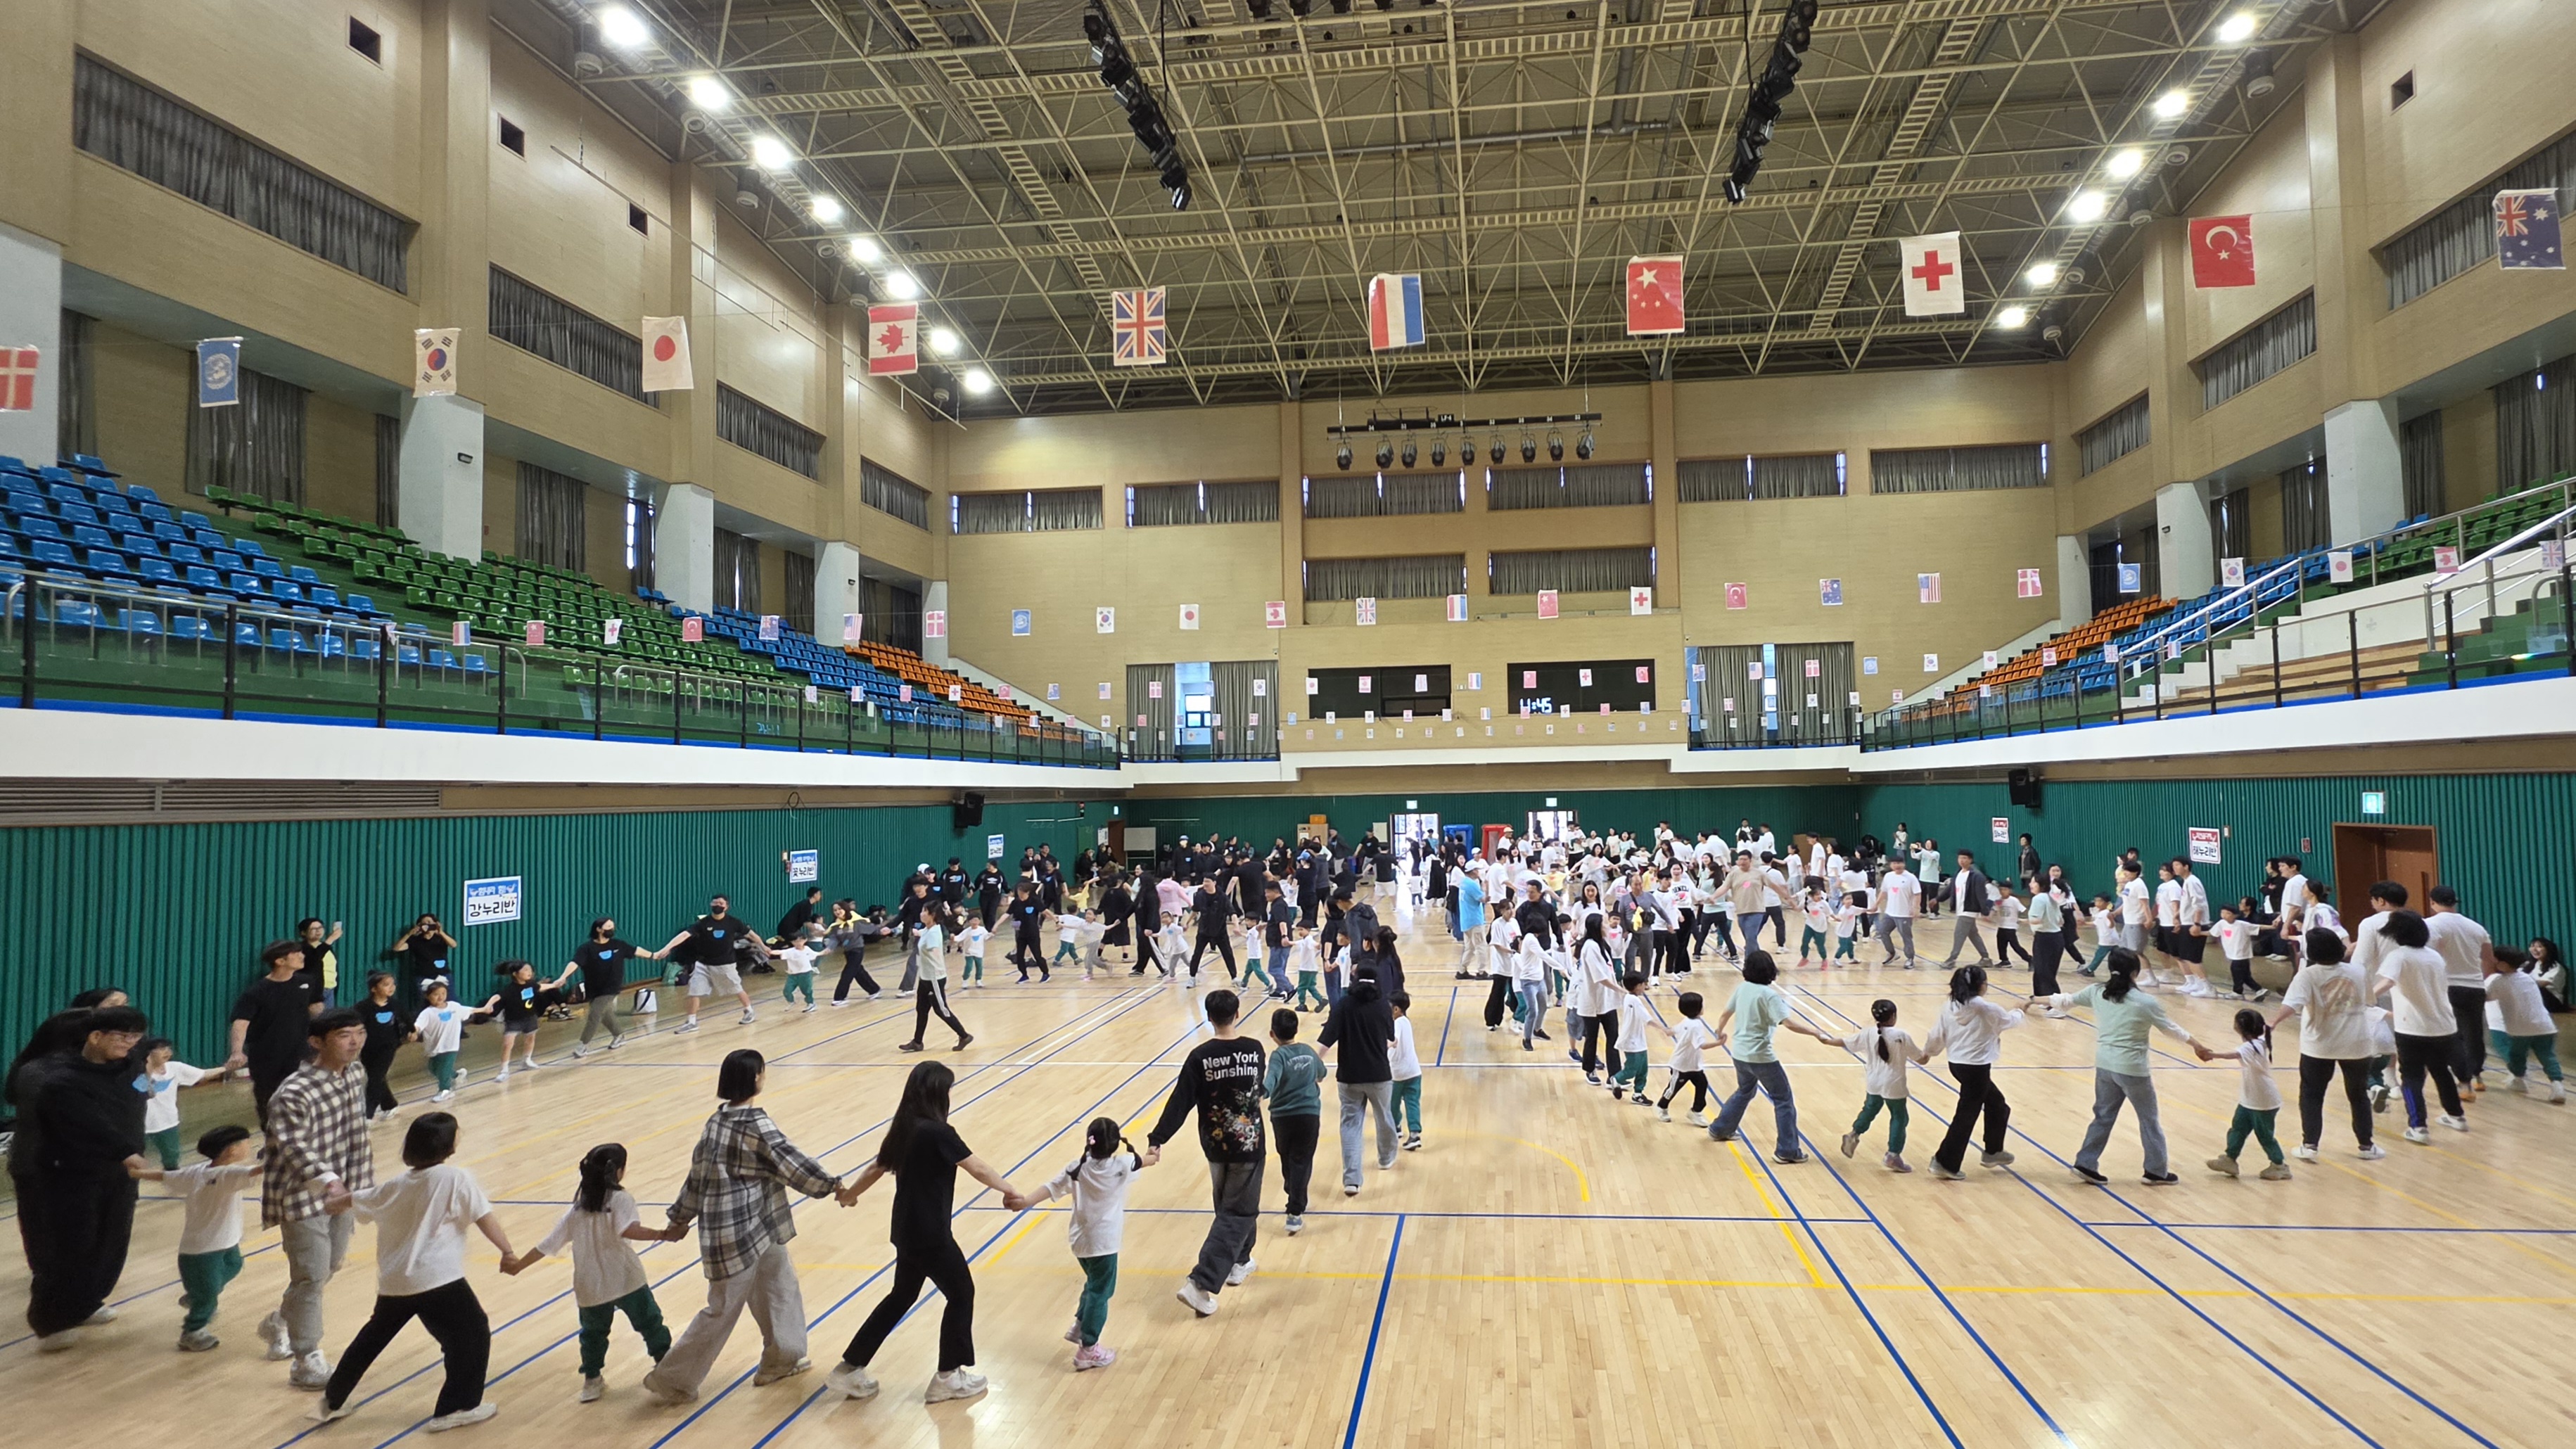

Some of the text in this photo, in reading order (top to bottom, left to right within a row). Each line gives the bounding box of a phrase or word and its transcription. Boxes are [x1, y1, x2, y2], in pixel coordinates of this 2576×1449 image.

[469, 900, 516, 917] 강누리반
[1202, 1051, 1259, 1070] New York
[1205, 1064, 1258, 1082] Sunshine
